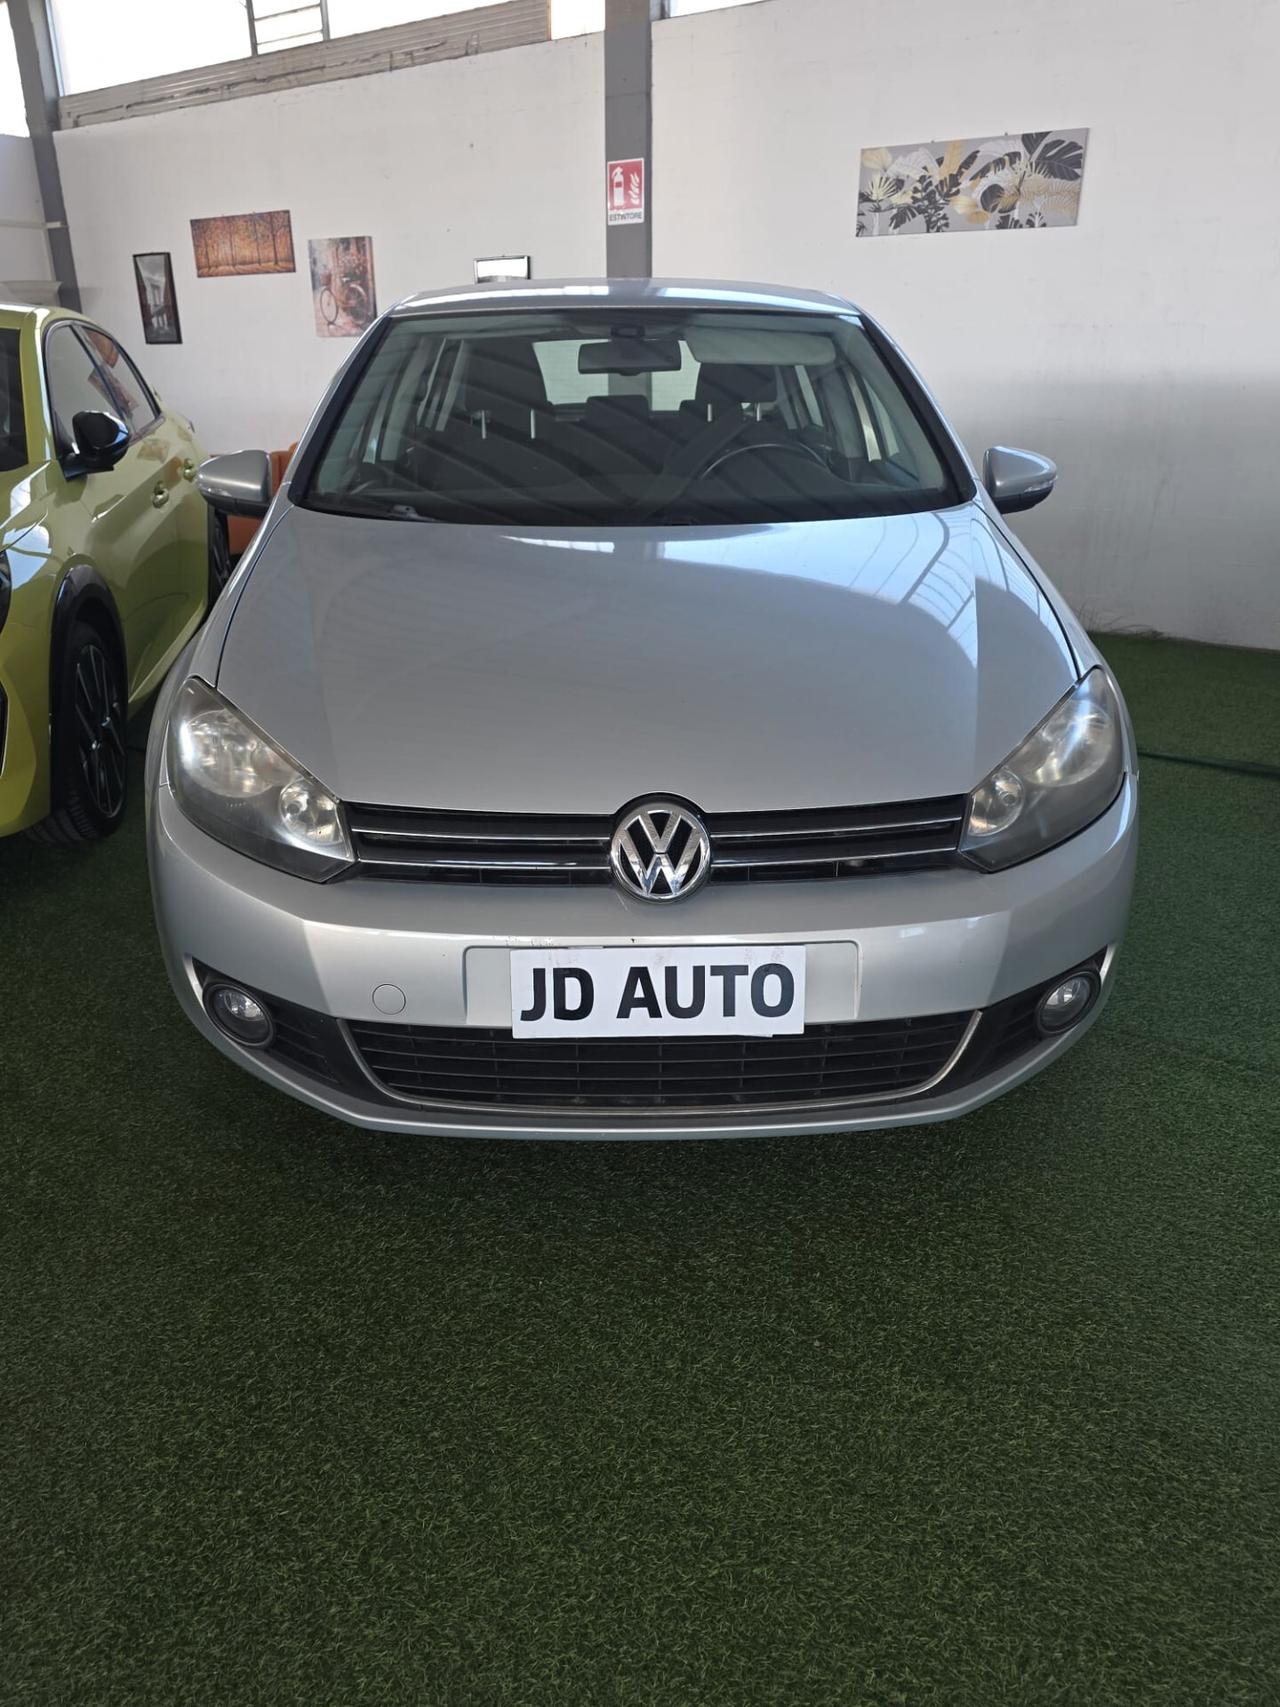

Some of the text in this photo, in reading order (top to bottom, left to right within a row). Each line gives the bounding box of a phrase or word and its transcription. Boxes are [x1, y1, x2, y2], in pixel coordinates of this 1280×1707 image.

[609, 211, 642, 221] ESTINTORE
[613, 804, 709, 899] VW
[520, 963, 795, 1021] JD AUTO
